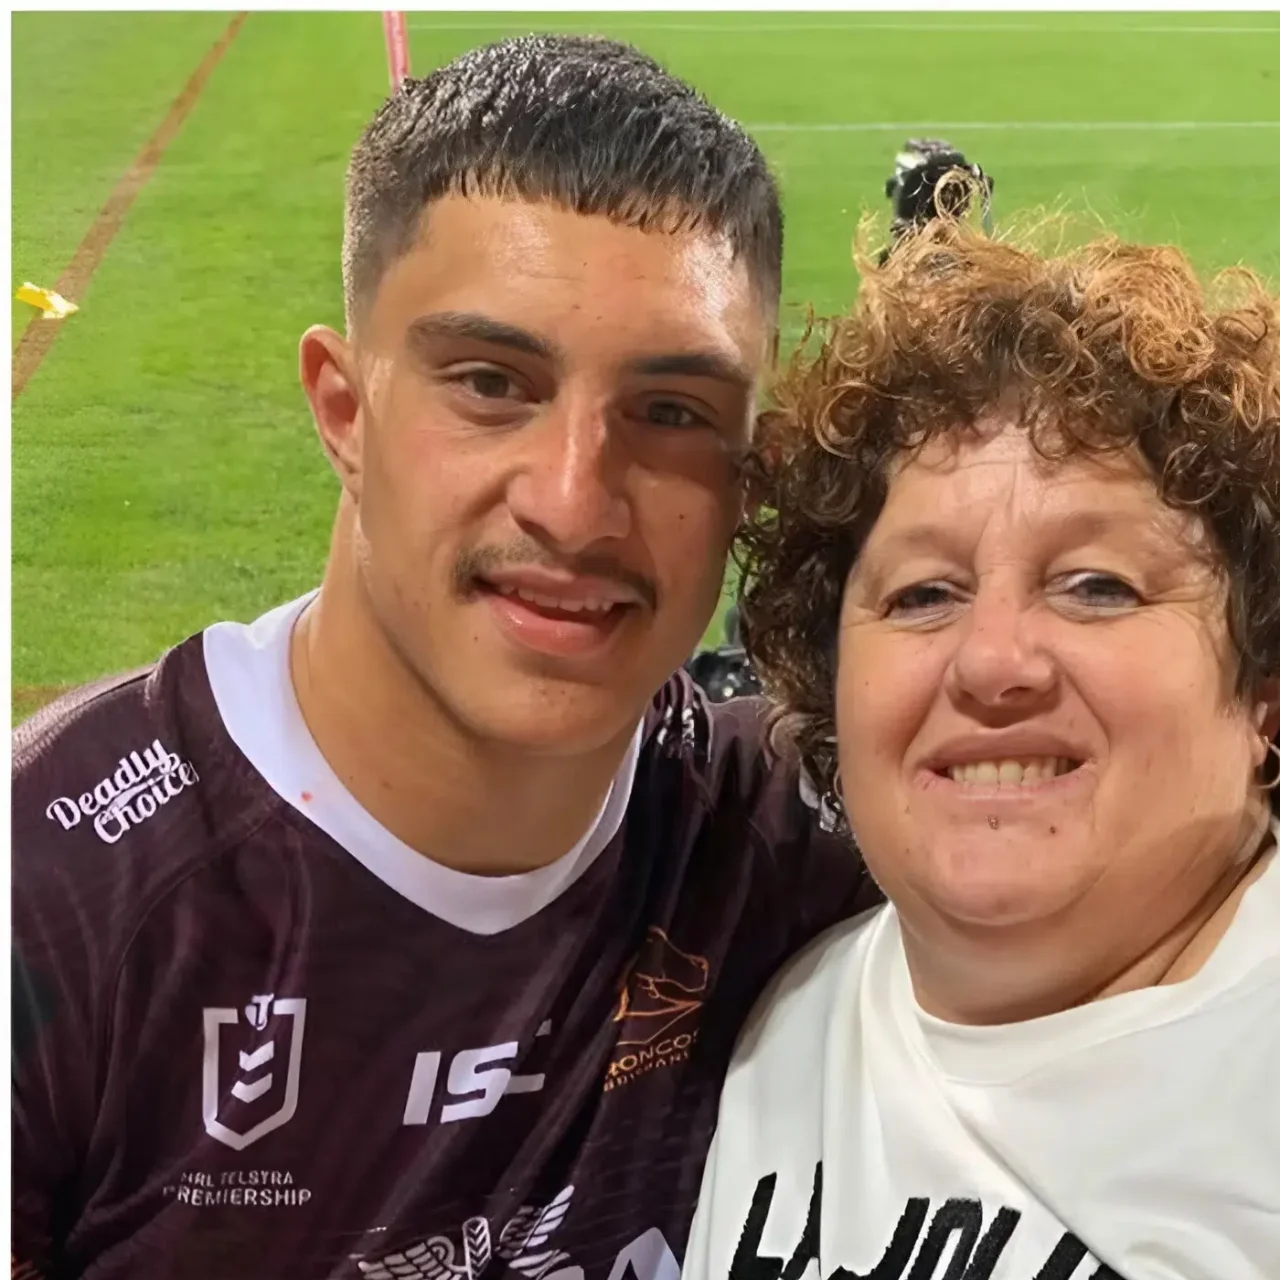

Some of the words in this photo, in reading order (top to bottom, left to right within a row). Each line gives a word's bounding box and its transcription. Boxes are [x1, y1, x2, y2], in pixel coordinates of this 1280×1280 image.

[46, 738, 181, 831] Deadly
[94, 760, 200, 844] Choice
[604, 1026, 700, 1080] ONCO
